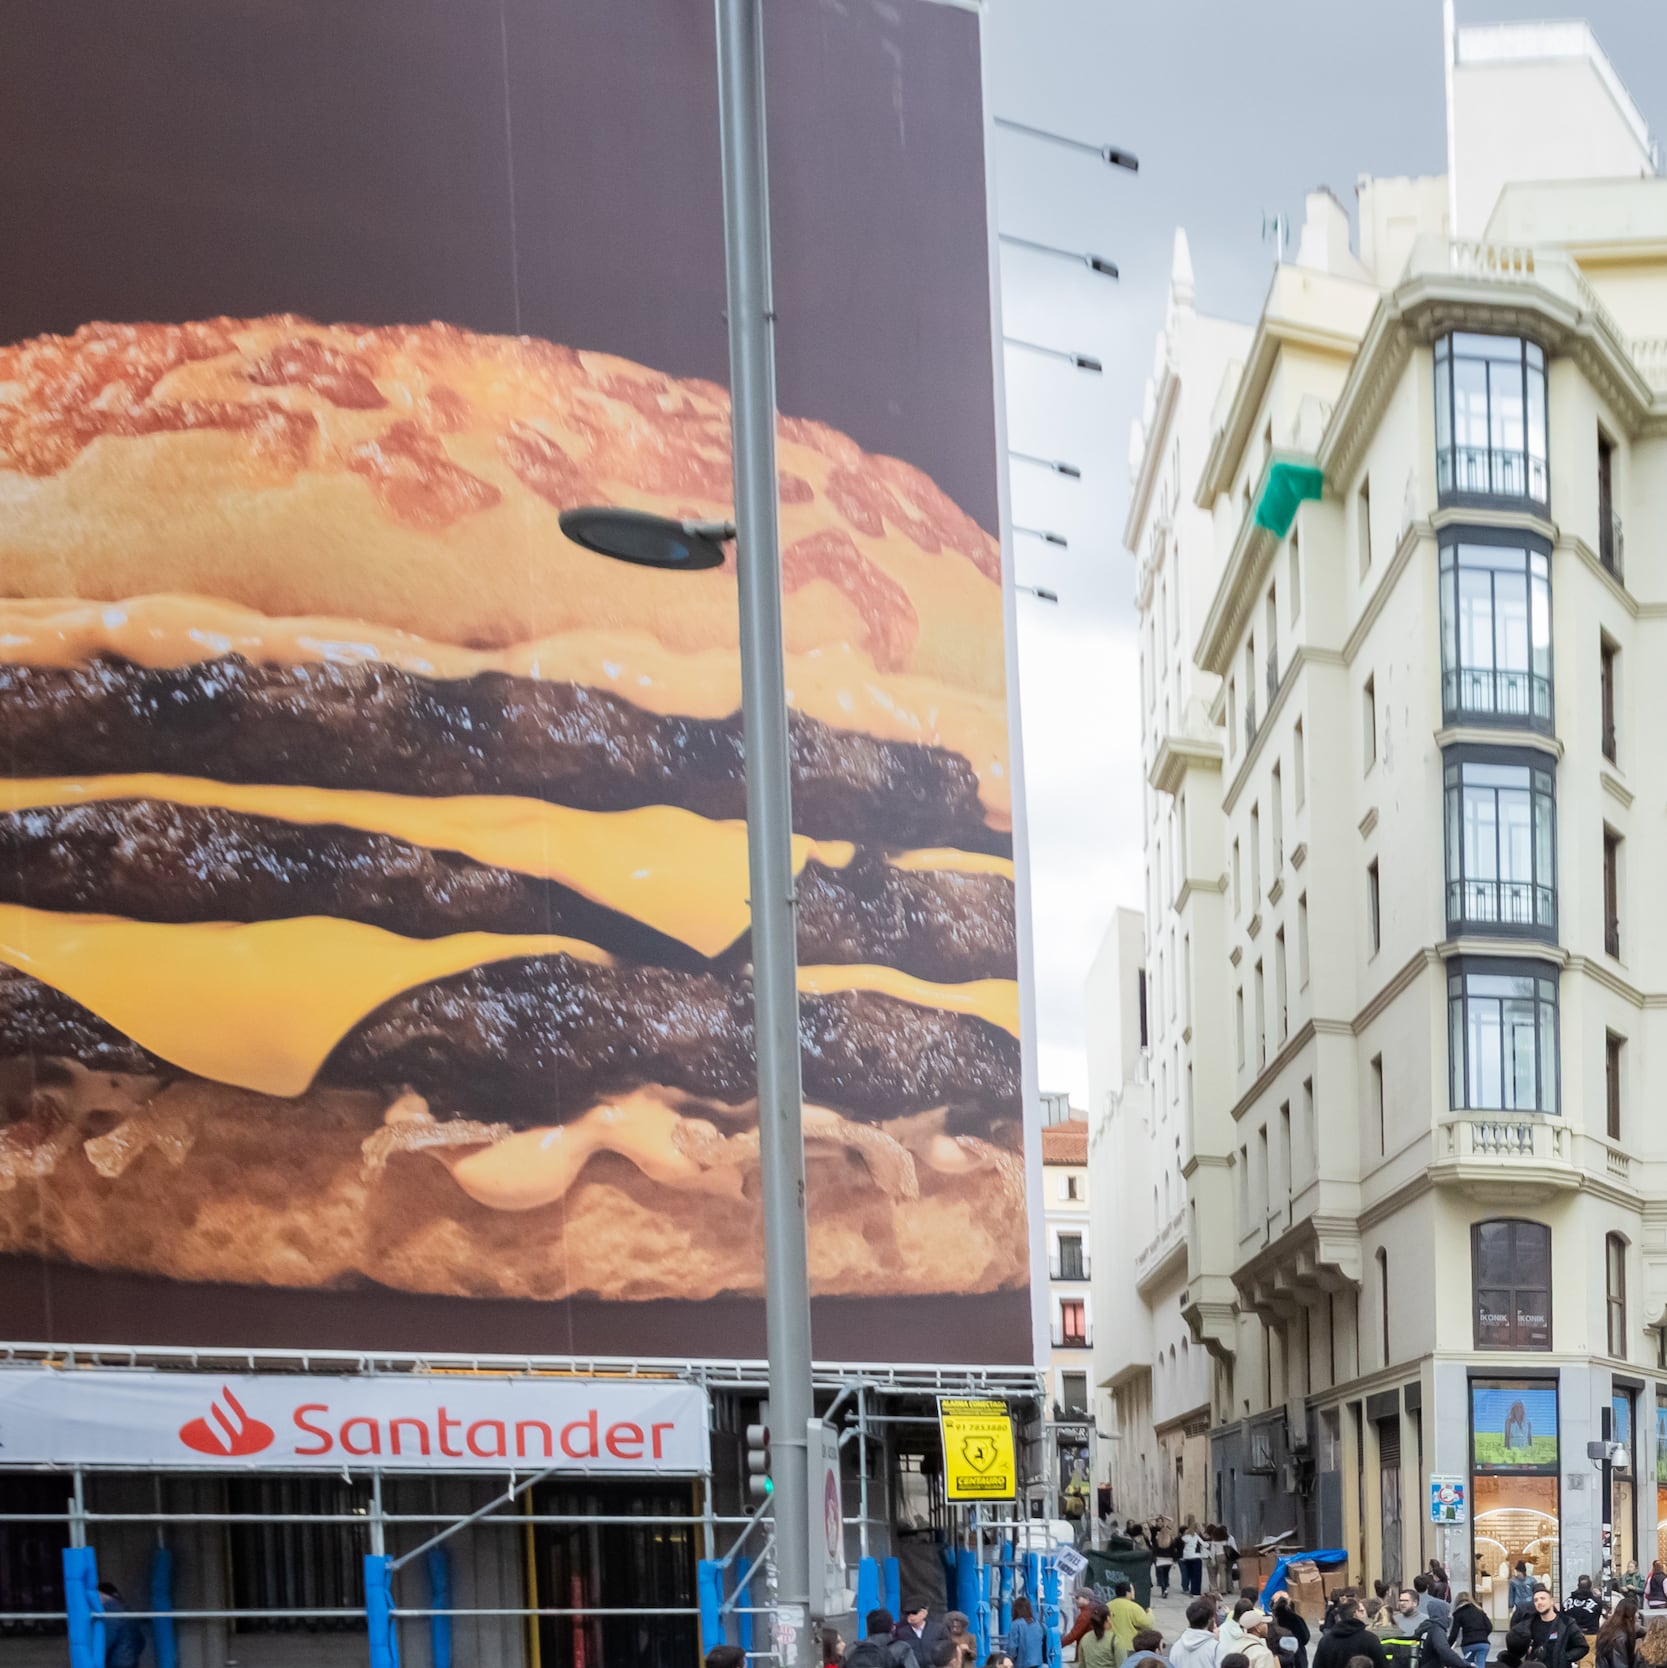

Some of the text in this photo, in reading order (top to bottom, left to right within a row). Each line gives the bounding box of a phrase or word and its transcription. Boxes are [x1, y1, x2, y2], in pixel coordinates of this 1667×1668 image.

[1480, 1314, 1507, 1322] IKONIK
[1517, 1314, 1545, 1322] IKONIK
[293, 1404, 674, 1460] Santander
